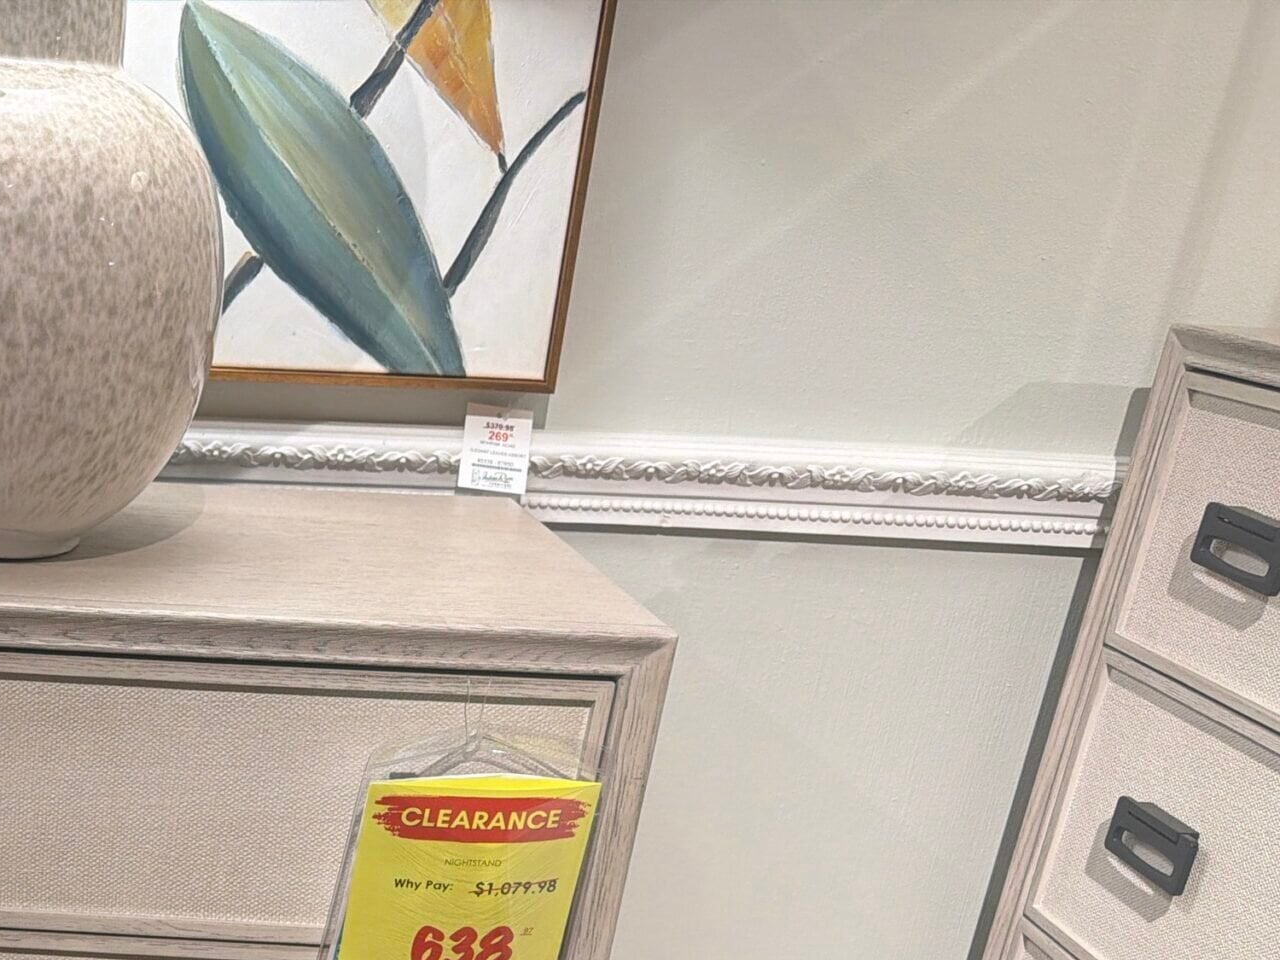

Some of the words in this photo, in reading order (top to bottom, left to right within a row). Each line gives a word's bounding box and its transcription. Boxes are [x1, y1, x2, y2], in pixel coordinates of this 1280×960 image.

[488, 430, 509, 442] 269
[400, 807, 562, 831] CLEARANCE
[443, 858, 502, 868] NIGHTSTAND
[394, 878, 422, 891] Why
[425, 879, 454, 893] Pay:
[474, 879, 558, 898] $1,079.98
